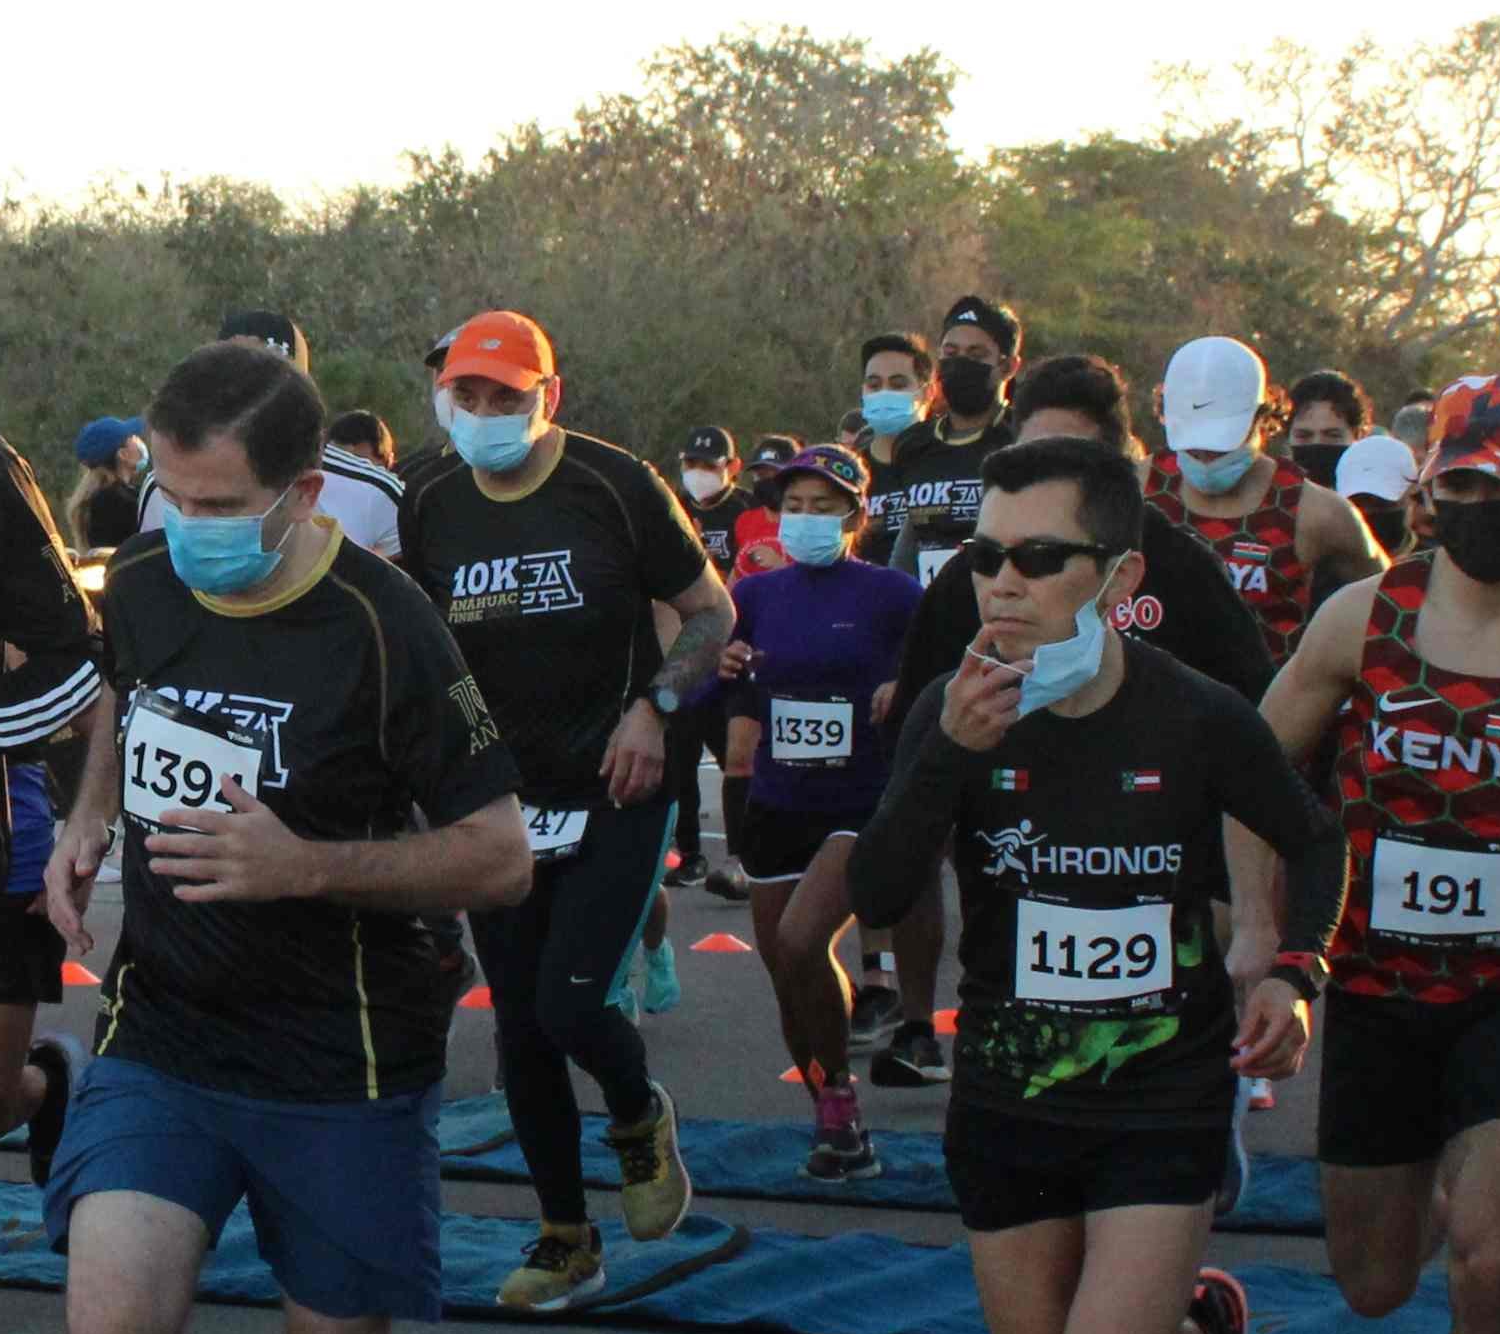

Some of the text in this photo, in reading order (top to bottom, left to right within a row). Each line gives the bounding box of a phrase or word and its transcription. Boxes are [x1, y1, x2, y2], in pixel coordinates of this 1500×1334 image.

[907, 481, 954, 508] 10K
[452, 556, 520, 598] 10K
[775, 715, 845, 747] 1339
[521, 805, 572, 837] 47
[1402, 870, 1487, 918] 191
[1029, 929, 1158, 980] 1129
